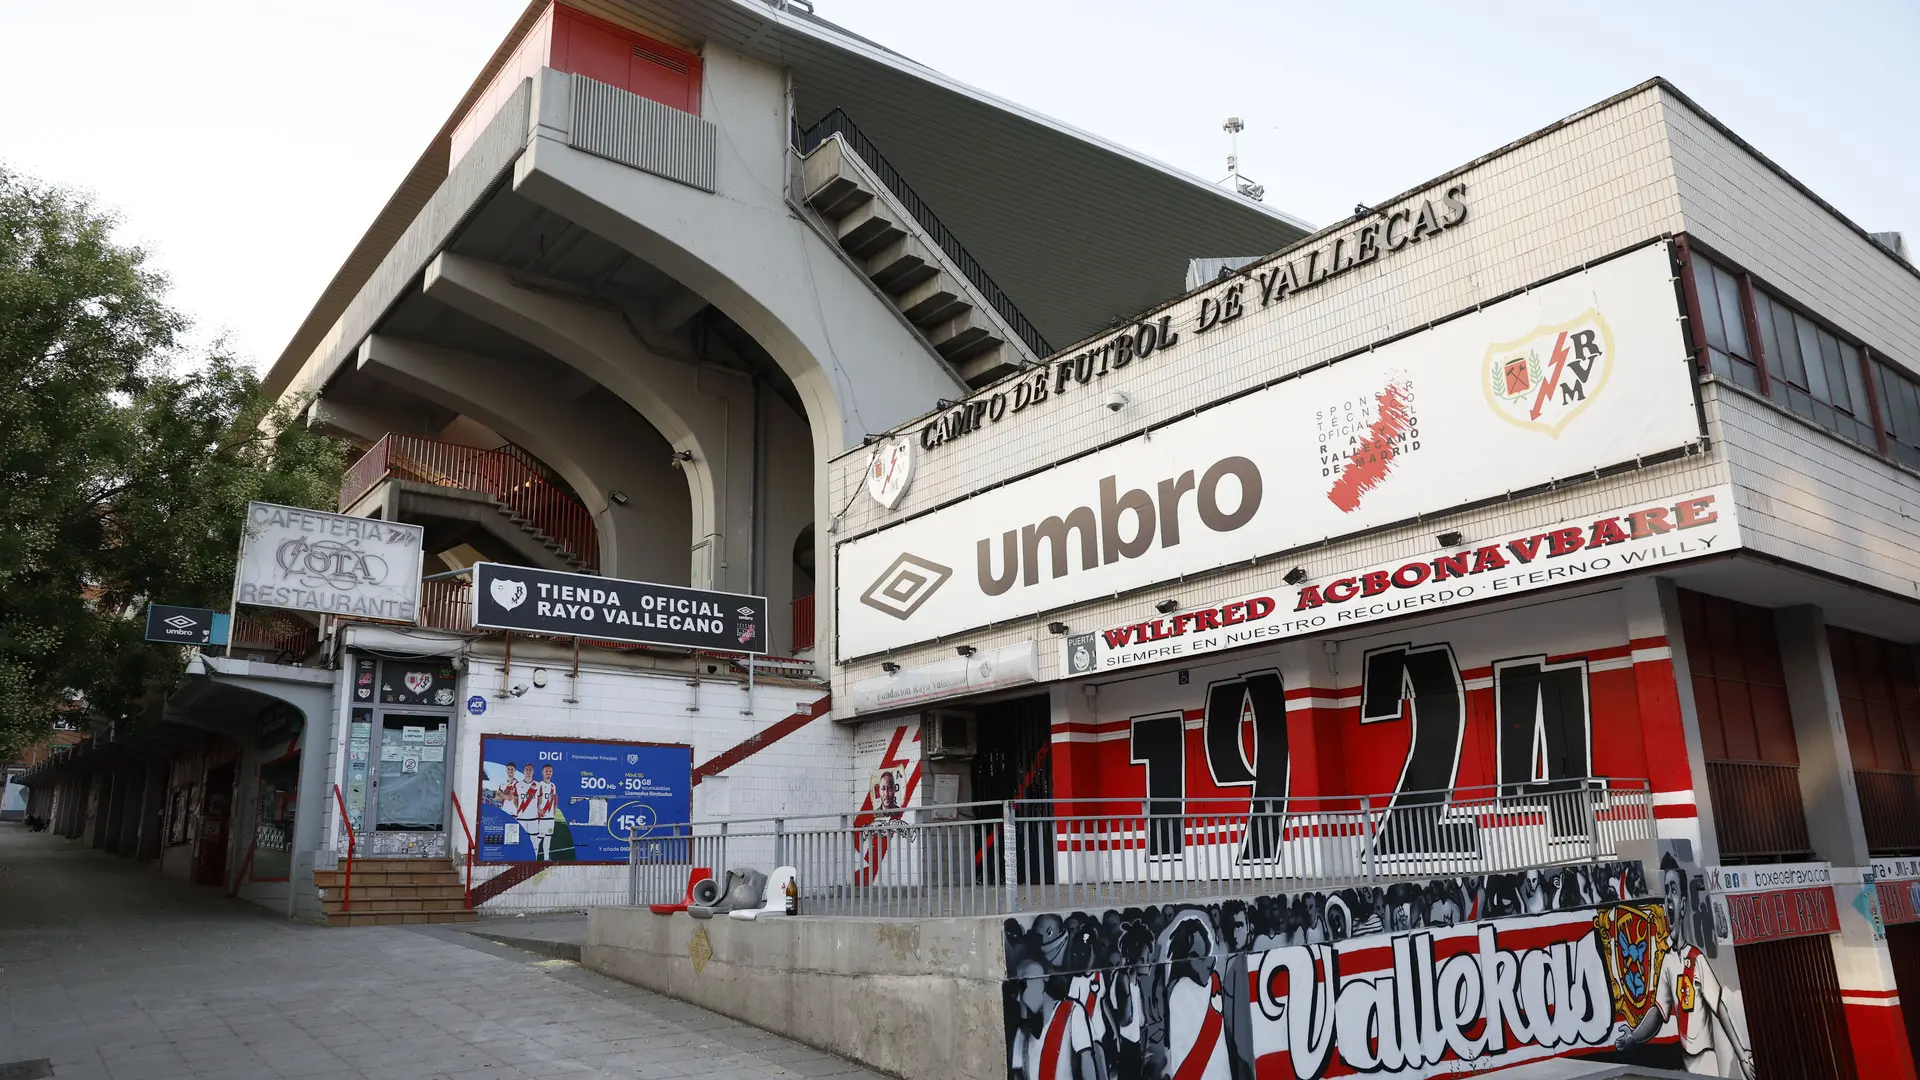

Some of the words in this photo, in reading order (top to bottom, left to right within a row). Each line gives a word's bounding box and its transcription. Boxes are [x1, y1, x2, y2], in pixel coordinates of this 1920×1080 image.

[920, 392, 1006, 451] CAMPO
[1011, 369, 1049, 413] DE
[1053, 315, 1179, 395] FUTBOL
[1194, 282, 1243, 333] DE
[1260, 183, 1467, 306] VALLECAS
[1316, 380, 1413, 420] SPONSOR
[1319, 420, 1371, 442] OFICIAL
[1320, 417, 1417, 454] RAYO
[1321, 429, 1419, 465] VALLECANO
[1322, 464, 1340, 477] DE
[1355, 441, 1421, 467] MADRID
[252, 507, 383, 541] CAFETERIA
[977, 456, 1262, 596] umbro
[1102, 596, 1276, 650] WILFRED
[1294, 495, 1719, 612] AGBONAVBARE
[242, 584, 414, 619] RESTAURANTE
[537, 582, 620, 606] TIENDA
[641, 595, 724, 618] OFICIAL
[537, 601, 595, 621] RAYO
[602, 608, 724, 634] VALLECANO
[1106, 644, 1183, 667] SIEMPRE
[1193, 637, 1217, 651] EN
[1227, 617, 1326, 646] NUESTRO
[1337, 586, 1475, 621] RECUERDO
[1493, 558, 1612, 590] ETERNO
[1621, 535, 1719, 565] WILLY
[1069, 635, 1094, 646] PUERTA
[539, 751, 563, 761] DIGI
[1130, 642, 1610, 866] 1924
[581, 777, 606, 790] 500
[625, 779, 641, 790] 50
[1754, 868, 1830, 887] boxeoelrayo.com
[1727, 895, 1772, 939] BOXEO
[1773, 893, 1795, 934] EL
[1795, 890, 1830, 932] RAYO
[1258, 923, 1615, 1079] Vallekas
